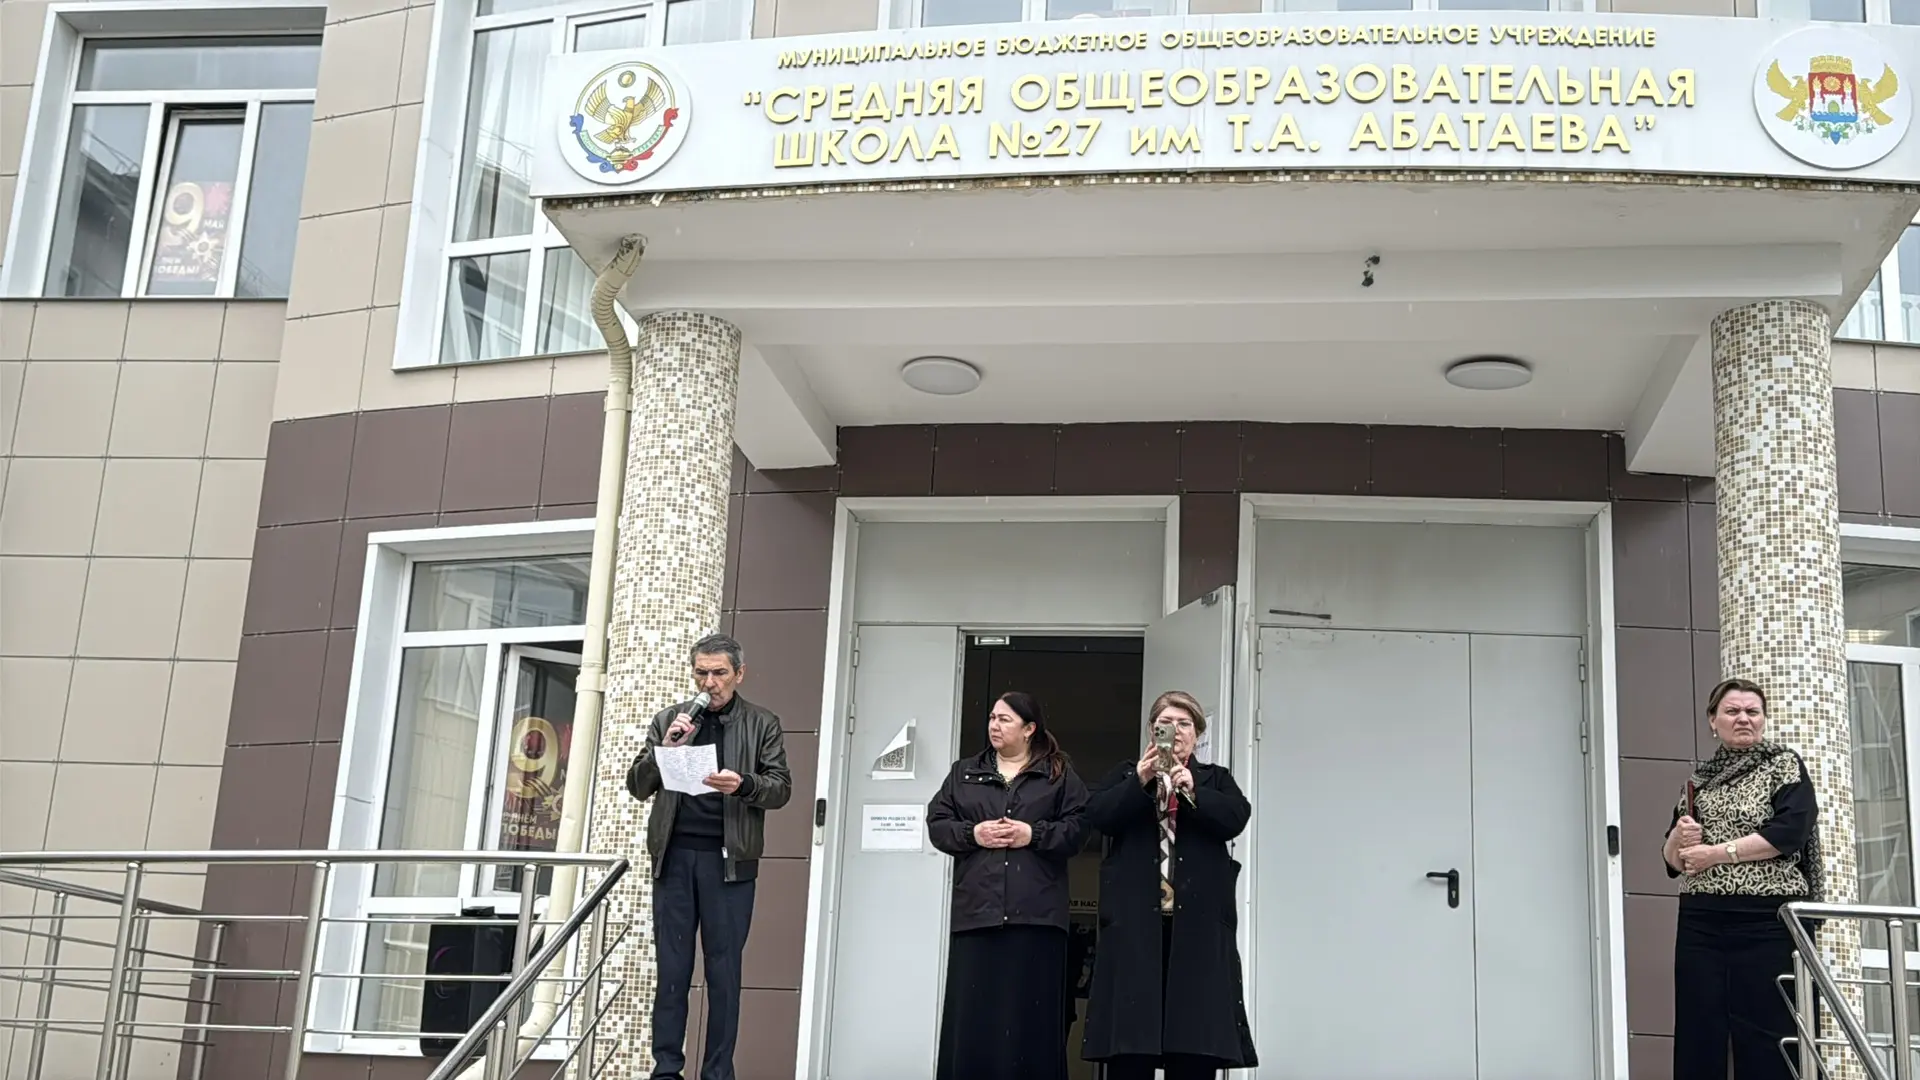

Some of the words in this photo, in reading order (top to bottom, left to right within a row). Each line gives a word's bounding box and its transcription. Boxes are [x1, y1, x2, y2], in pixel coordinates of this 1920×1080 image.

[776, 38, 986, 69] МУНИЦИПАЛЬНОЕ
[996, 31, 1148, 55] БЮДЖЕТНОЕ
[1160, 23, 1480, 49] ОБЩЕОБРАЗОВАТЕЛЬНОЕ
[1489, 24, 1657, 48] УЧРЕЖДЕНИЕ
[1010, 63, 1696, 114] ОБЩЕОБРАЗОВАТЕЛЬНАЯ
[773, 121, 961, 169] ШКОЛА
[989, 118, 1102, 160] №27
[1227, 112, 1321, 153] Т.А.
[162, 182, 204, 245] 9
[507, 717, 558, 798] 9
